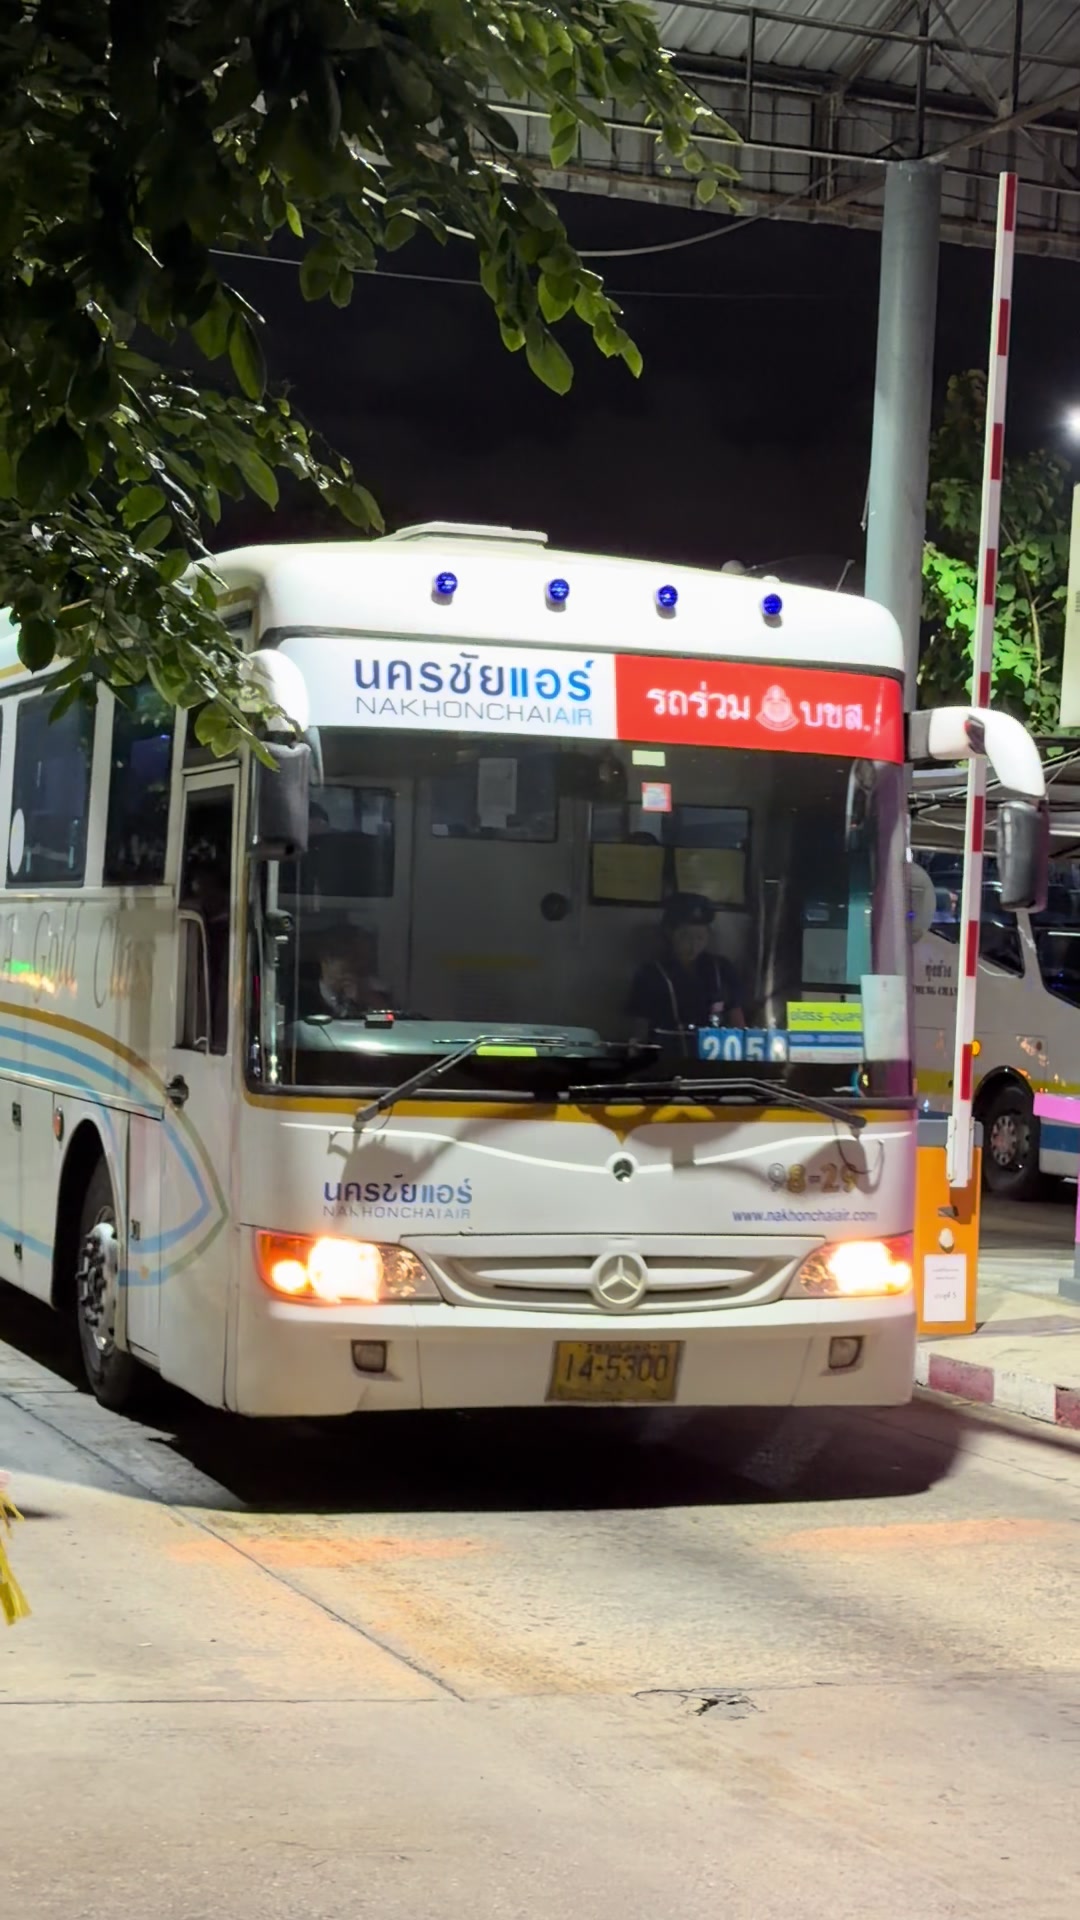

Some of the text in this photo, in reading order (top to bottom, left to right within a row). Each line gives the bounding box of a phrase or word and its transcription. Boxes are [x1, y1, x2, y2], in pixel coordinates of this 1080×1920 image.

[355, 652, 594, 701] นครชัยแอร์
[356, 697, 593, 726] NAKHONCHAIAIR
[647, 681, 871, 732] รถร่วม บขส.
